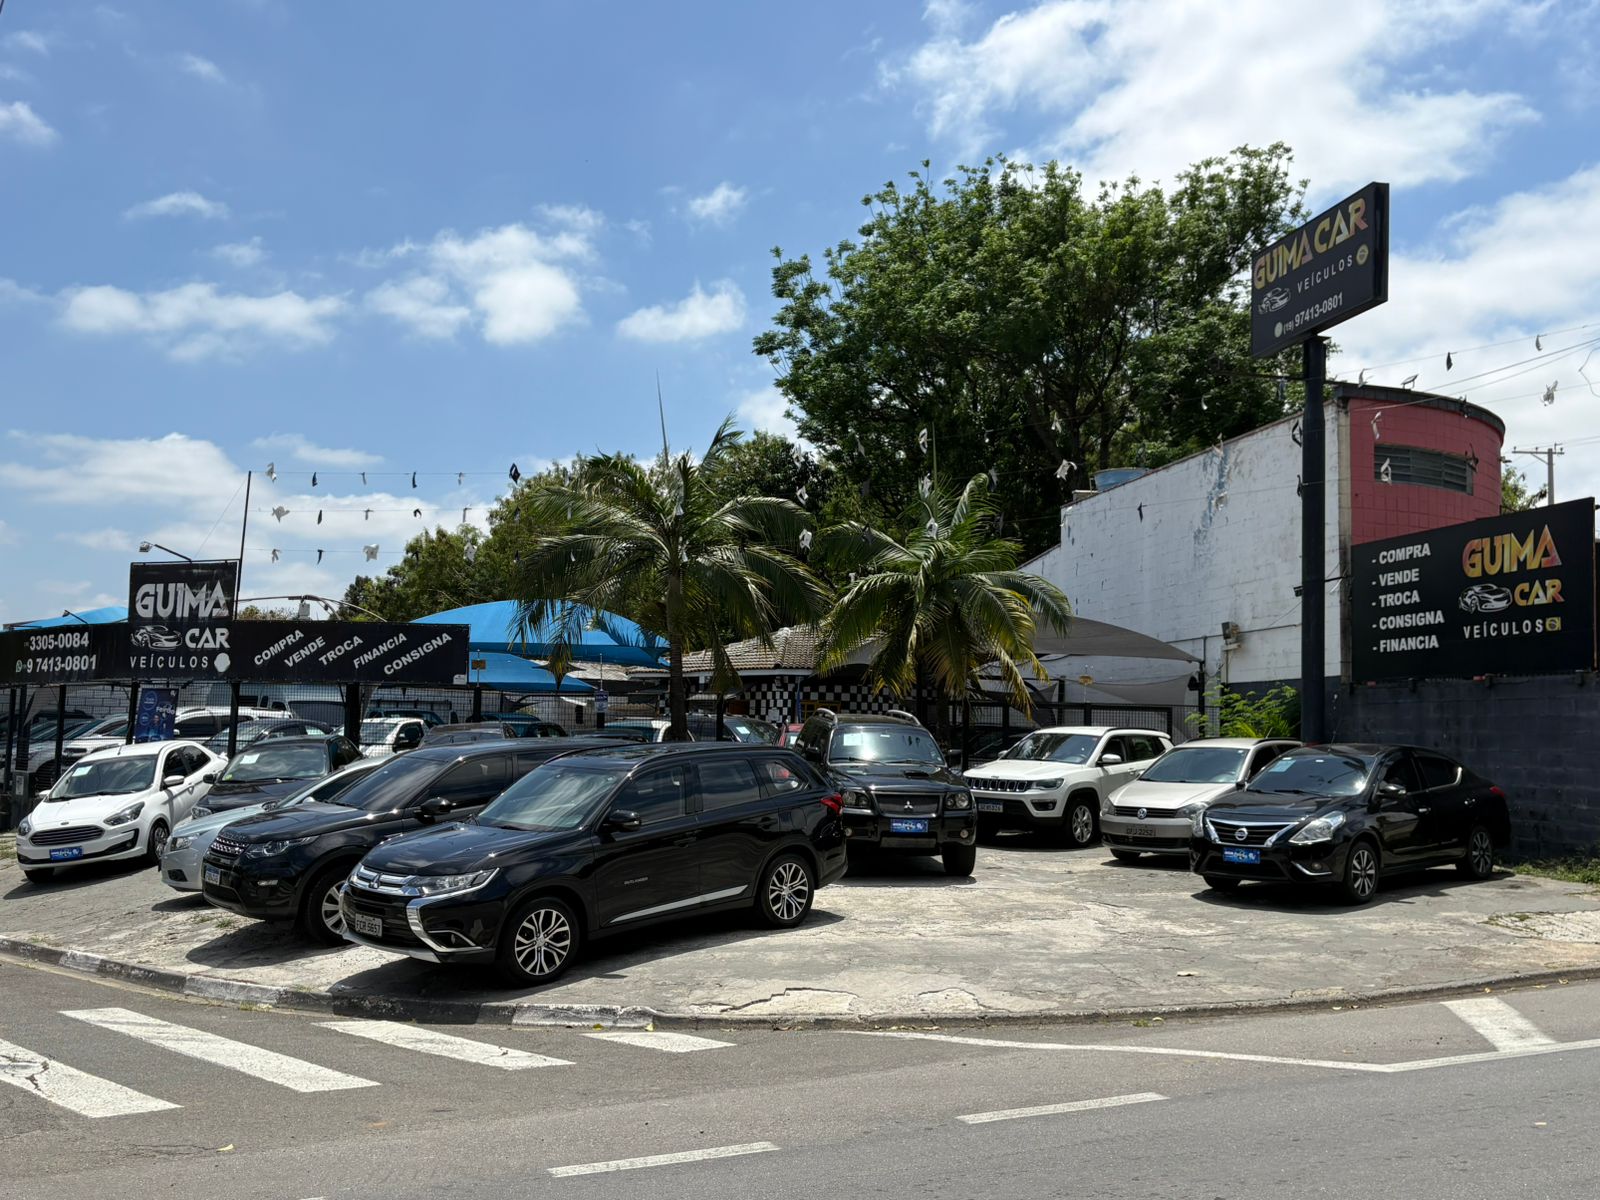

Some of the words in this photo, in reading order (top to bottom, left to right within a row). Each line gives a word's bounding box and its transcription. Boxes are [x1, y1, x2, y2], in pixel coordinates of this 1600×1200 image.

[1254, 229, 1313, 289] GUIMA
[1314, 198, 1368, 253] CAR
[1295, 292, 1343, 327] 97413-0801
[1379, 543, 1431, 564] COMPRA
[1462, 524, 1562, 578] GUIMA
[1379, 568, 1420, 587] VENDE
[135, 580, 230, 618] GUIMA
[1379, 590, 1420, 608] TROCA
[1514, 579, 1564, 607] CAR
[1379, 610, 1445, 630] CONSIGNA
[1463, 618, 1543, 639] VEÍCULOS
[30, 632, 90, 651] 3305-0084
[185, 627, 231, 649] CAR
[254, 629, 304, 666] COMPRA
[284, 636, 326, 668] VENDE
[318, 635, 364, 666] TROCA
[353, 632, 407, 669] FINANCIA
[1379, 635, 1439, 653] FINANCIA
[130, 653, 209, 669] VEÍCULOS
[383, 632, 452, 675] CONSIGNA
